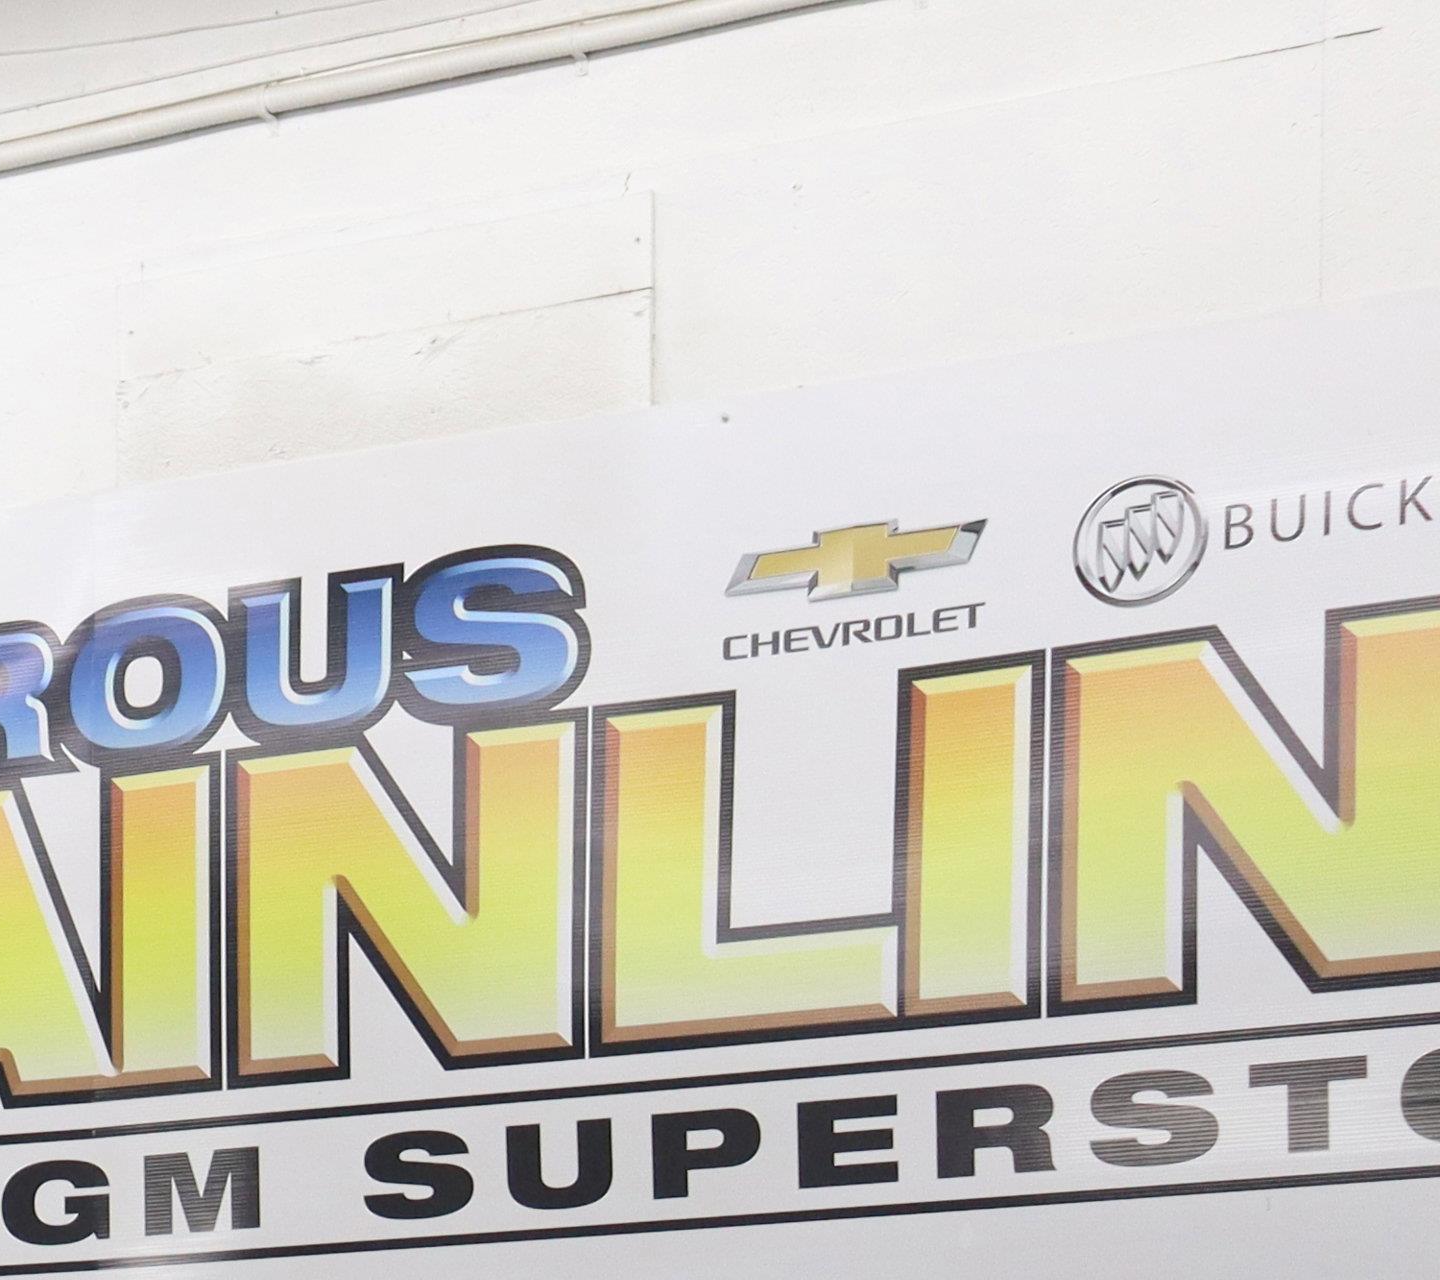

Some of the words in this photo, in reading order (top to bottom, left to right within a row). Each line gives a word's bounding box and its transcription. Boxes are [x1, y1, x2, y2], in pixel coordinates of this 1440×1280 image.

[1223, 476, 1435, 550] BUICK
[722, 602, 987, 661] CHEVROLET
[0, 1145, 263, 1247] GM
